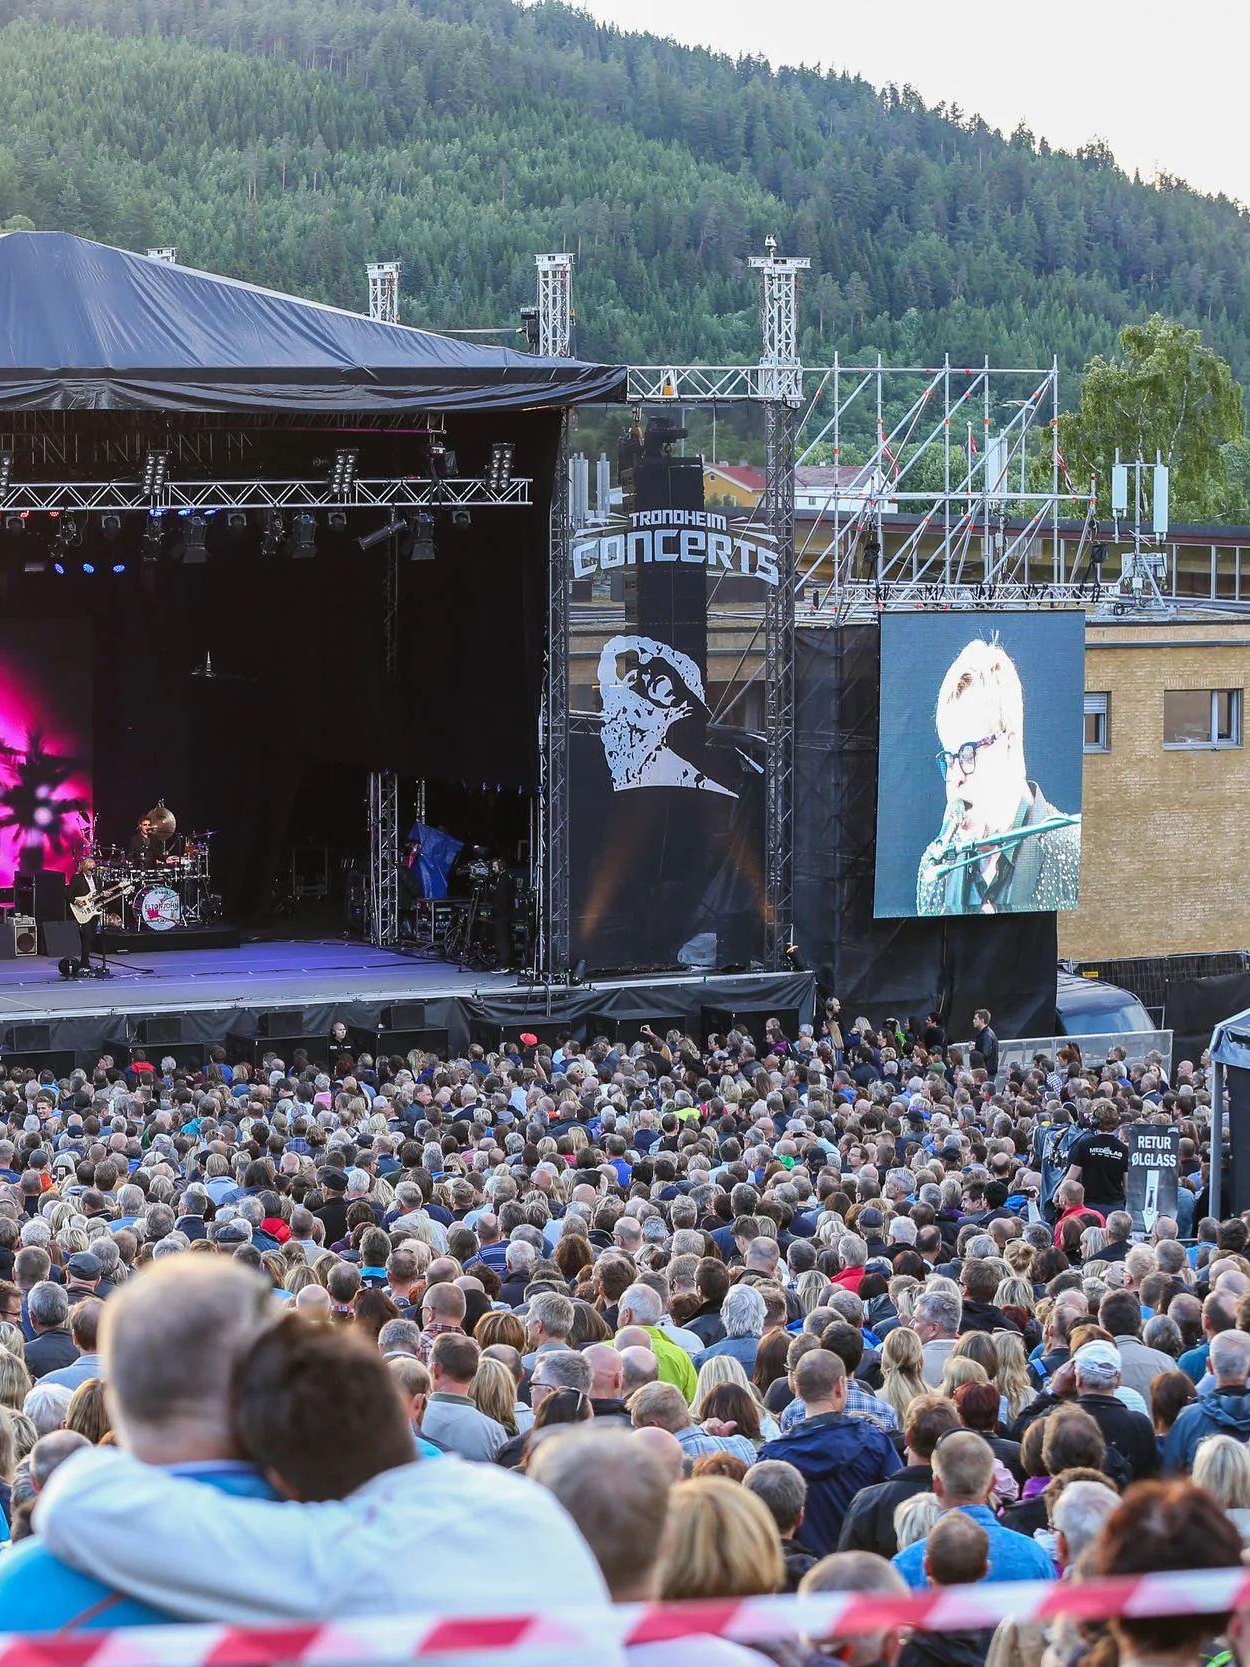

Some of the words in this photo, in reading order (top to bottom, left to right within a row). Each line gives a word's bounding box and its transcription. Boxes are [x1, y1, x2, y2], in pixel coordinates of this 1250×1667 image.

[629, 509, 727, 531] TRONDHEIM
[573, 529, 779, 586] CONCERTS
[1137, 1135, 1172, 1150] RETUR
[1131, 1152, 1177, 1168] ØLGLASS
